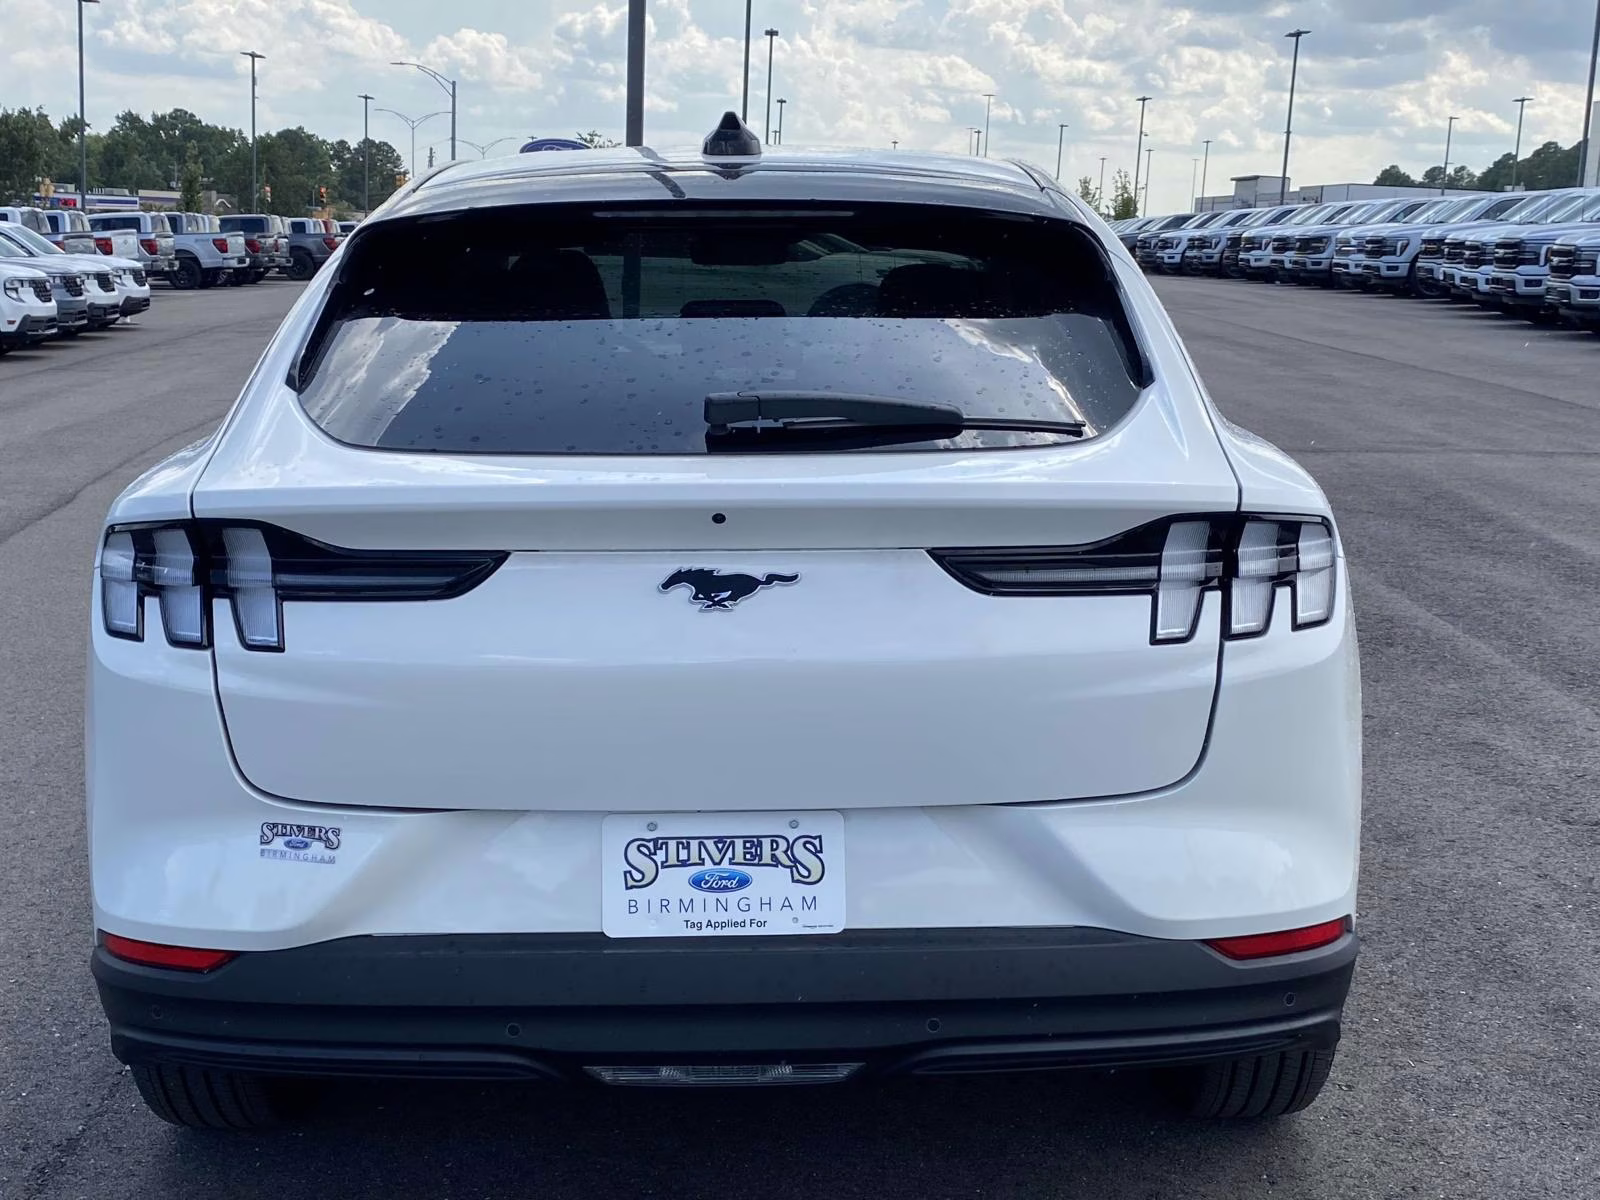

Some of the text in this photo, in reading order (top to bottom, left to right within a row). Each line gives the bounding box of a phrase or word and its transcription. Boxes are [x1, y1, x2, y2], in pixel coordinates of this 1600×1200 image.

[260, 822, 341, 850] STIVERS
[260, 848, 336, 864] BIRMINGHAM
[624, 835, 825, 890] STIVERS
[701, 872, 740, 889] Ford
[628, 896, 817, 914] BIRMINGHAM
[684, 919, 767, 930] Tag Applied For
